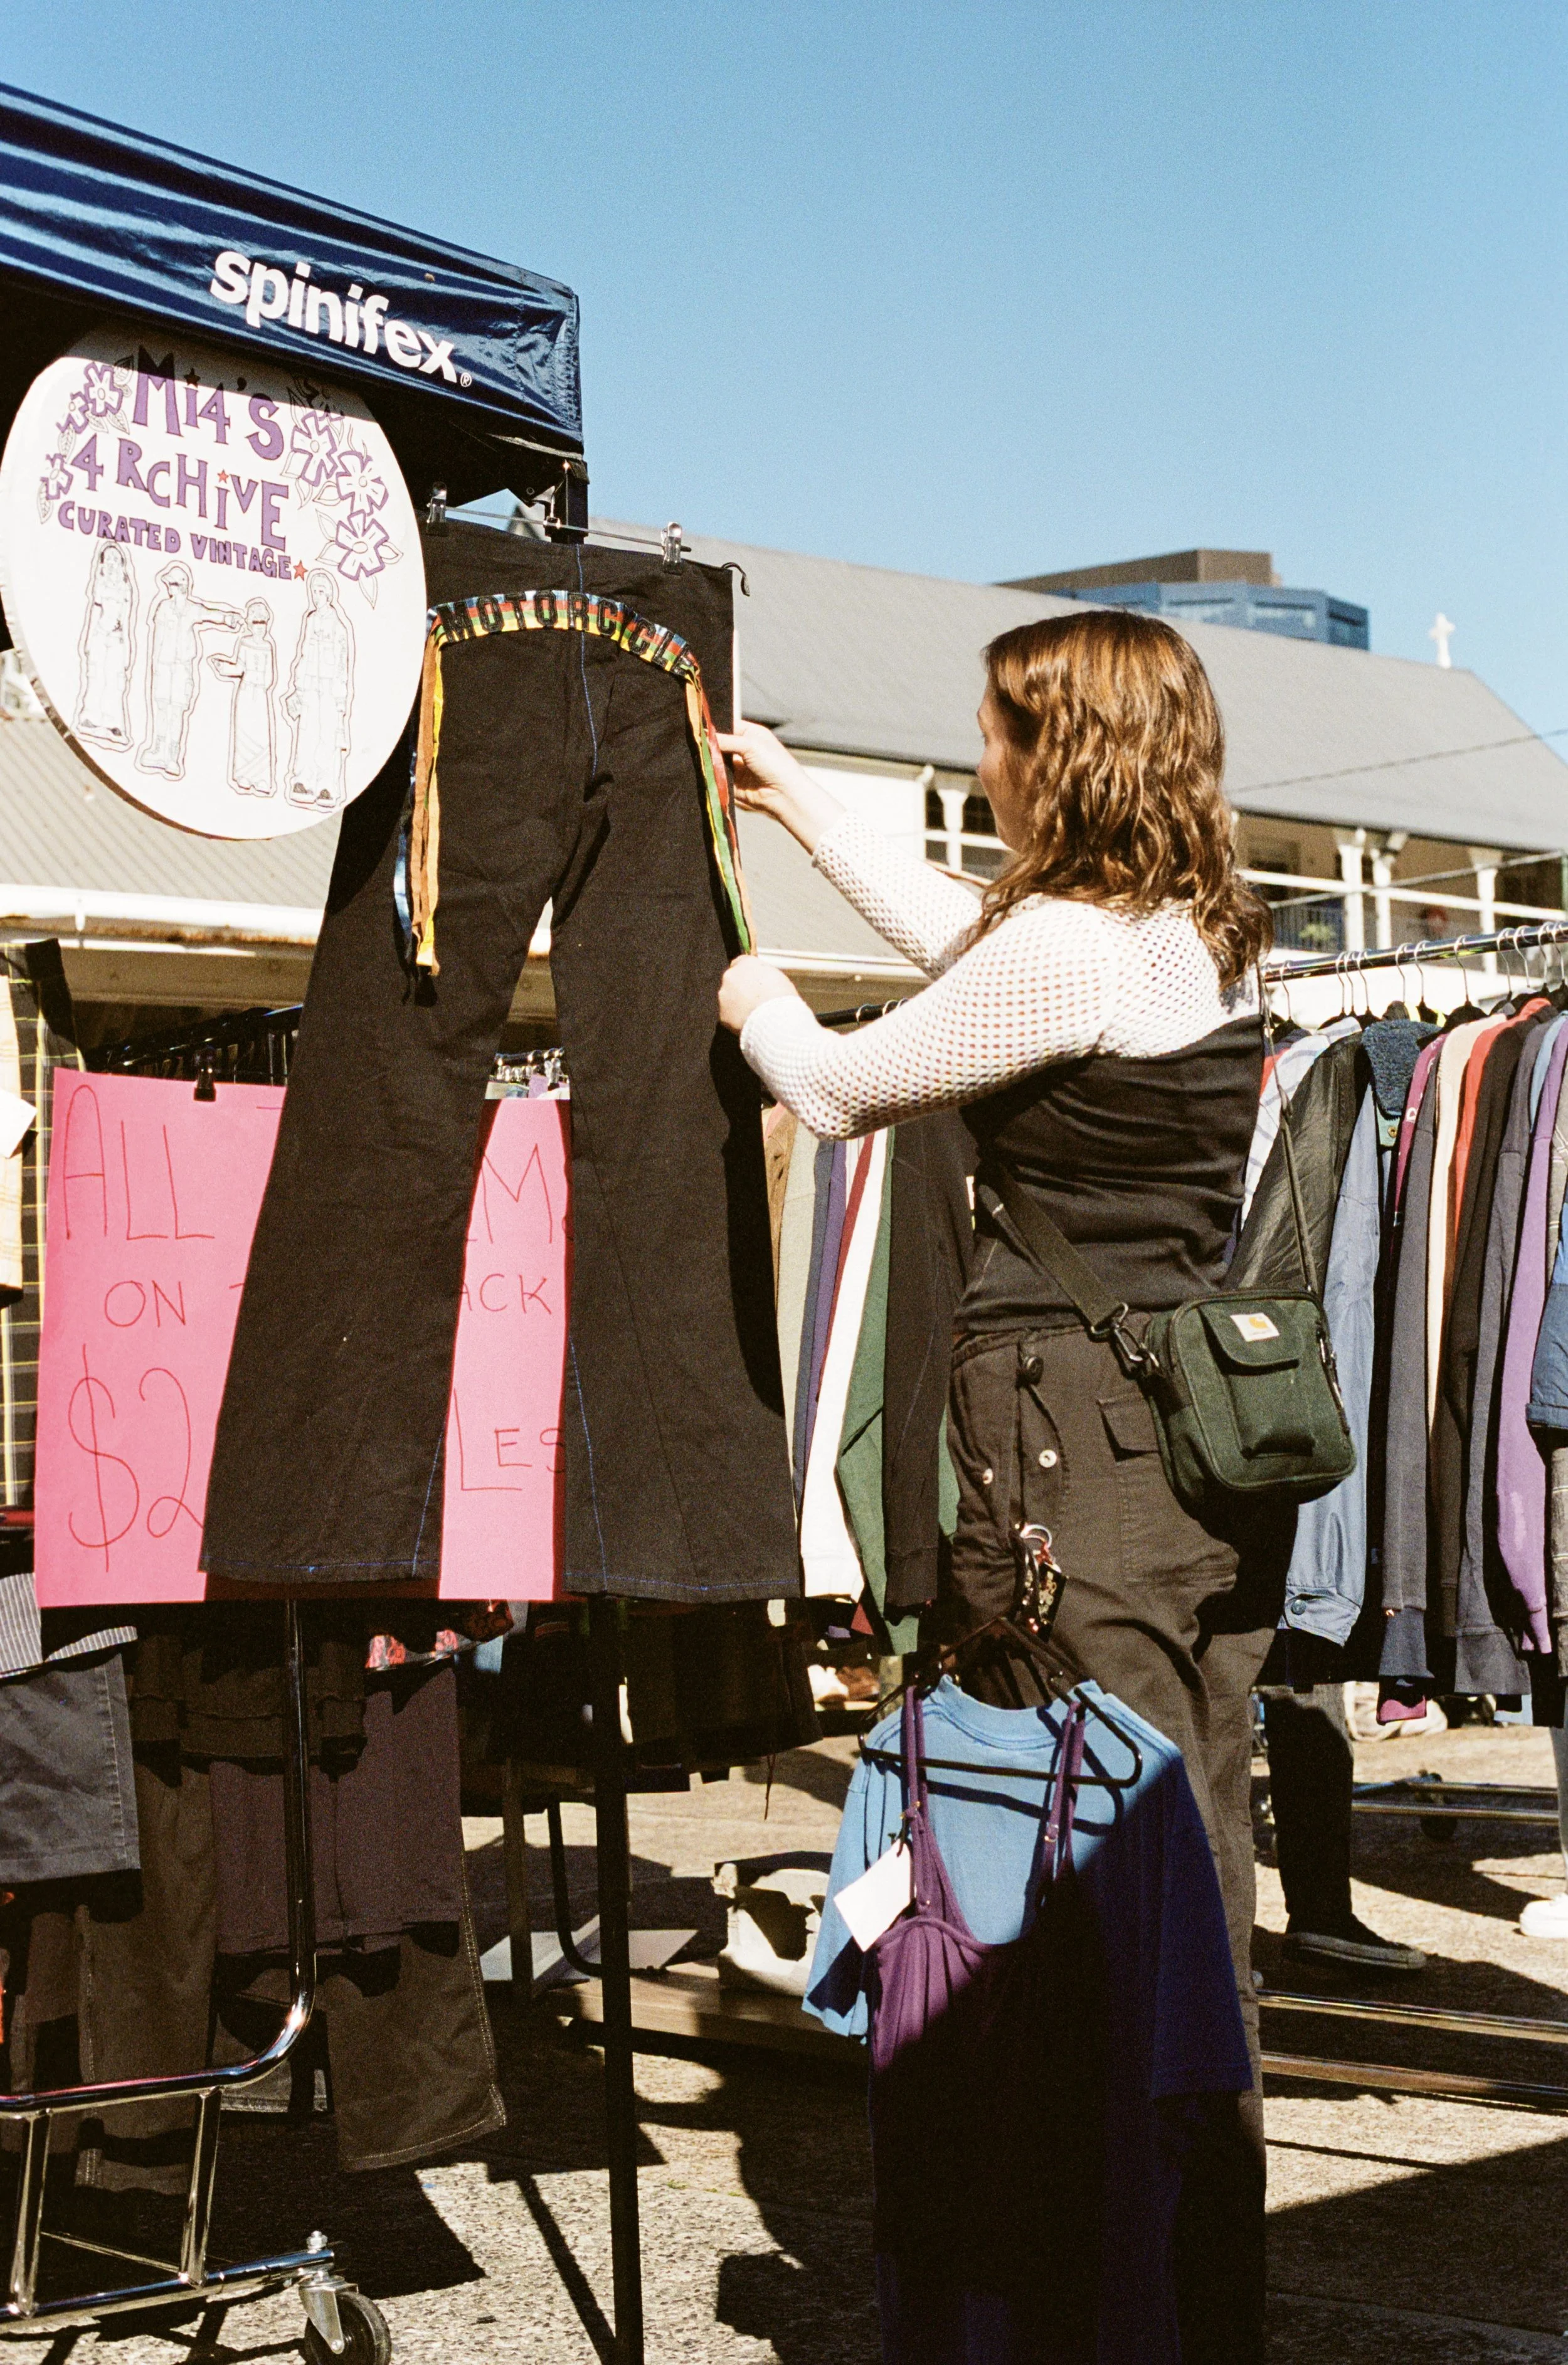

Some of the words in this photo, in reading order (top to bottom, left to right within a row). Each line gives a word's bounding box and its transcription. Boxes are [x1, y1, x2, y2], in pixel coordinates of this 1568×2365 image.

[58, 501, 181, 553] CURATED
[190, 533, 292, 580] VINTAGE
[438, 589, 696, 678] MOTORCYCLE
[63, 1085, 215, 1240] ALL
[104, 1280, 187, 1327] ON
